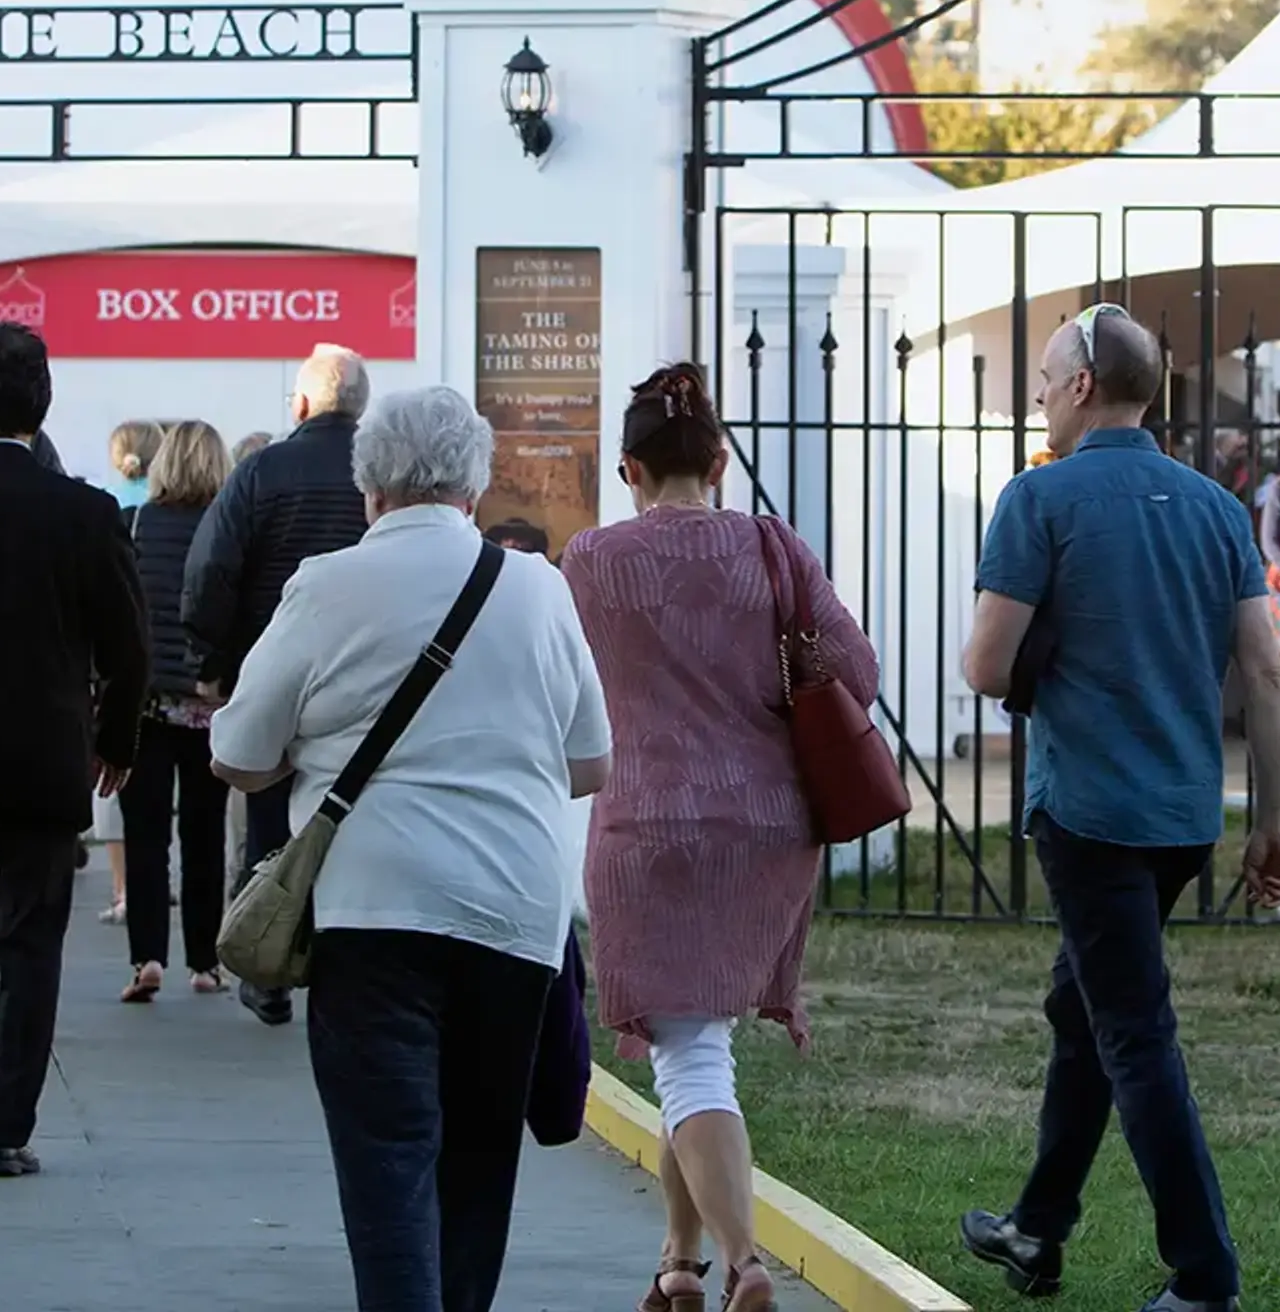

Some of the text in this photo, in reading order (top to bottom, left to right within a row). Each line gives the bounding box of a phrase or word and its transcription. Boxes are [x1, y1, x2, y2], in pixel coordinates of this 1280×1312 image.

[108, 6, 364, 59] BEACH
[97, 288, 340, 322] BOX OFFICE
[521, 312, 566, 328] THE
[484, 333, 568, 349] TAMING
[481, 354, 524, 371] THE
